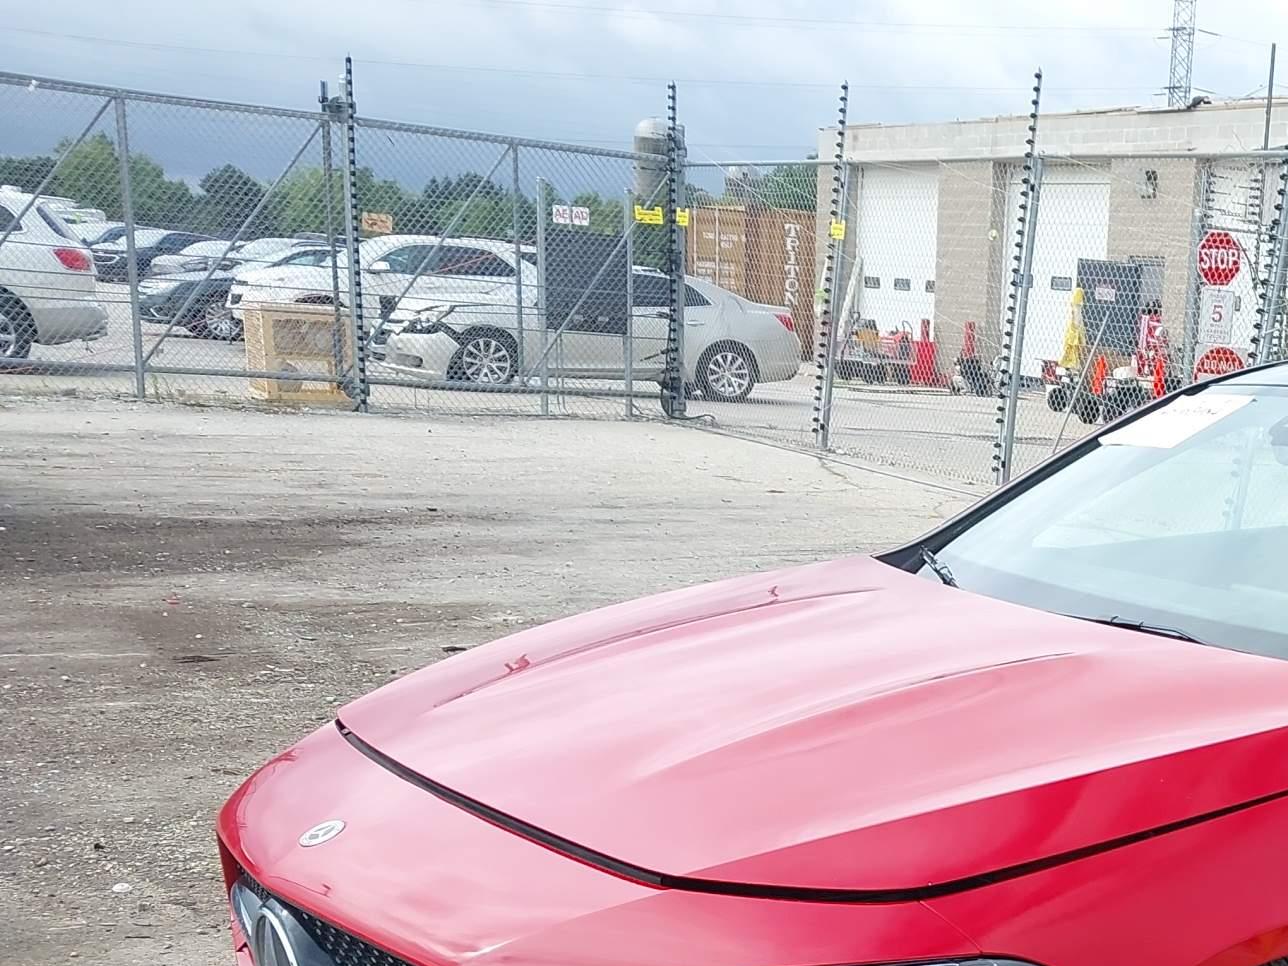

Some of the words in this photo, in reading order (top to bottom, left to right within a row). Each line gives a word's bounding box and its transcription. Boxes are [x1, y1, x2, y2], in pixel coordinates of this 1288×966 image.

[783, 223, 800, 306] TRITON
[1201, 247, 1238, 269] STOP
[1211, 304, 1223, 323] 5
